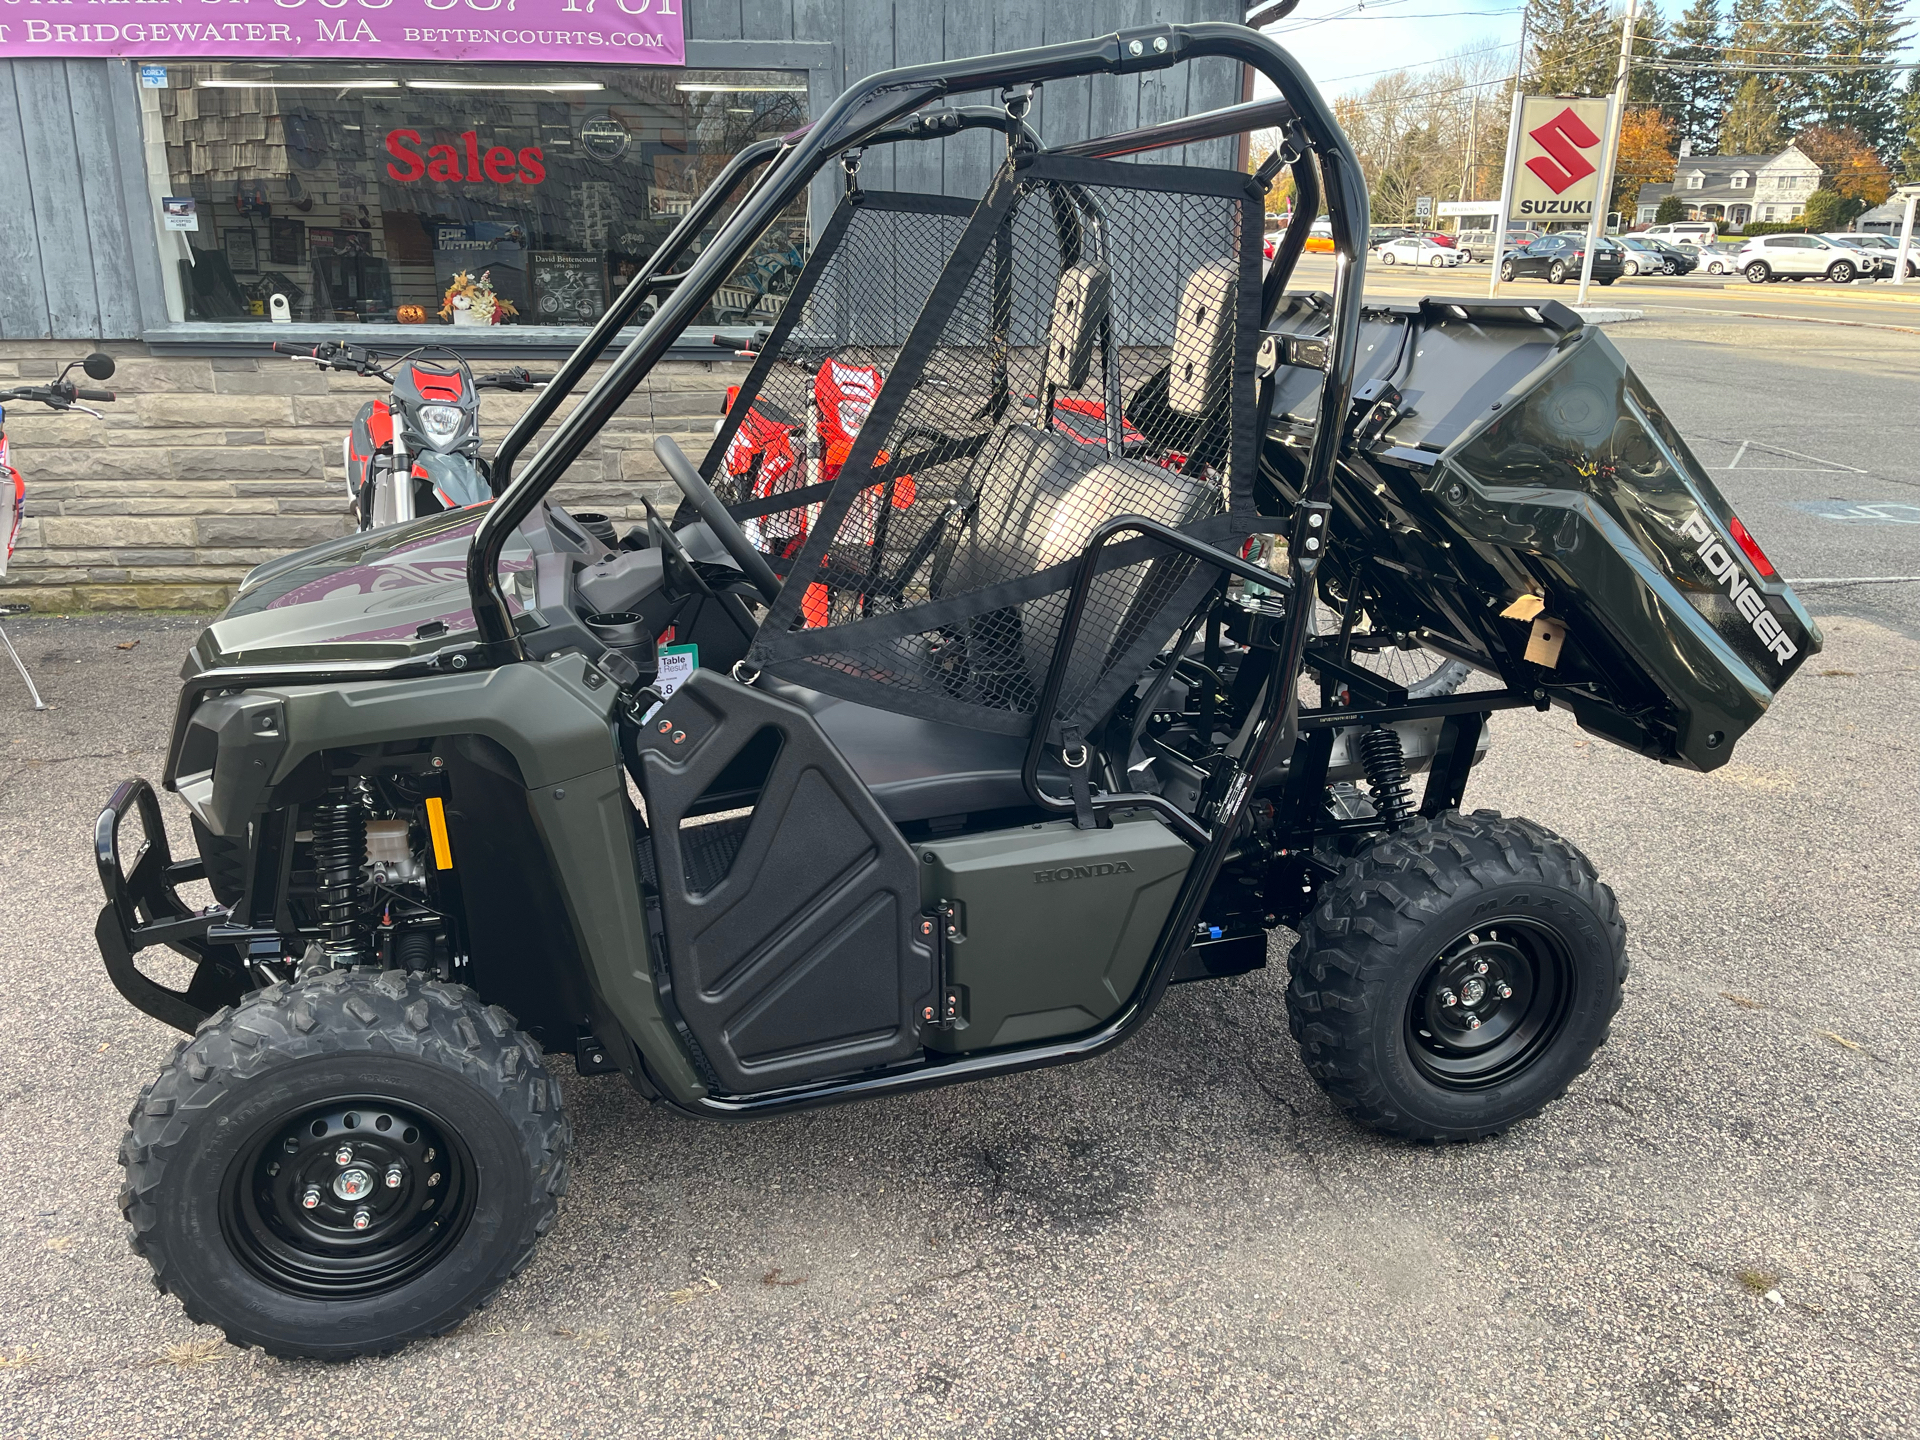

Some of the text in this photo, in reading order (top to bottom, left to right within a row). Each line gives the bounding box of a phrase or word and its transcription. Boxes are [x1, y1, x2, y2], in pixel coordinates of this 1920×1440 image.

[314, 17, 381, 43] MA
[403, 27, 664, 48] BETTENCOURTS.COM
[142, 69, 165, 77] LOREX
[385, 128, 546, 185] Sales
[1416, 207, 1429, 215] 30
[1520, 199, 1592, 214] SUZUKI
[438, 228, 467, 241] EPIC
[1679, 508, 1798, 666] PIONEER
[662, 656, 686, 665] Table
[664, 663, 688, 673] Result
[1033, 860, 1135, 884] HONDA
[1470, 893, 1601, 957] MAXXIS
